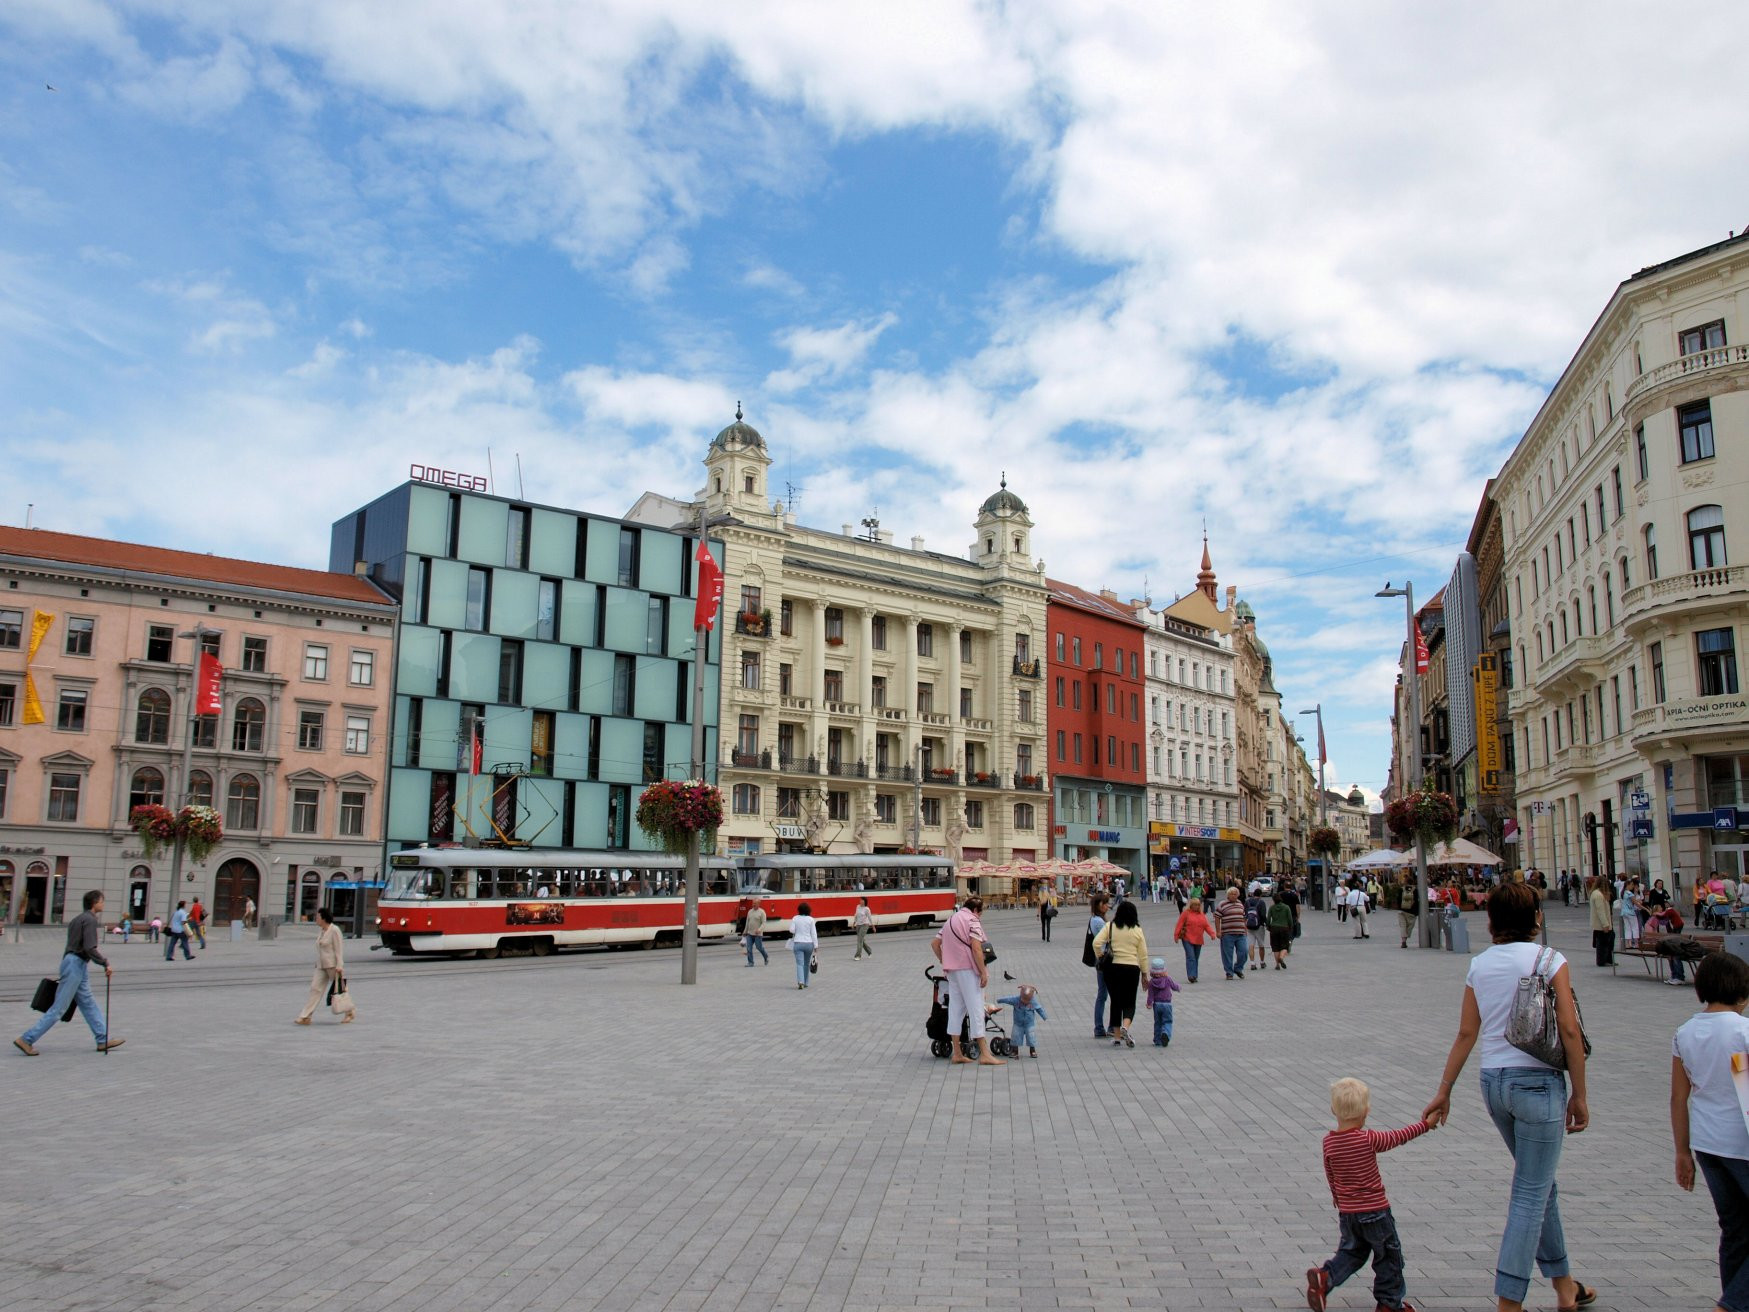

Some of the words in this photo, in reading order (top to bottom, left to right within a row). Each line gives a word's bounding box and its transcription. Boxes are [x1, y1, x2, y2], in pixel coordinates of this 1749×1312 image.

[410, 464, 487, 492] OMEGA
[1712, 701, 1746, 711] OPTIKA
[1533, 801, 1544, 813] T
[1715, 818, 1732, 826] AXA
[1184, 826, 1217, 837] INTERSPORT
